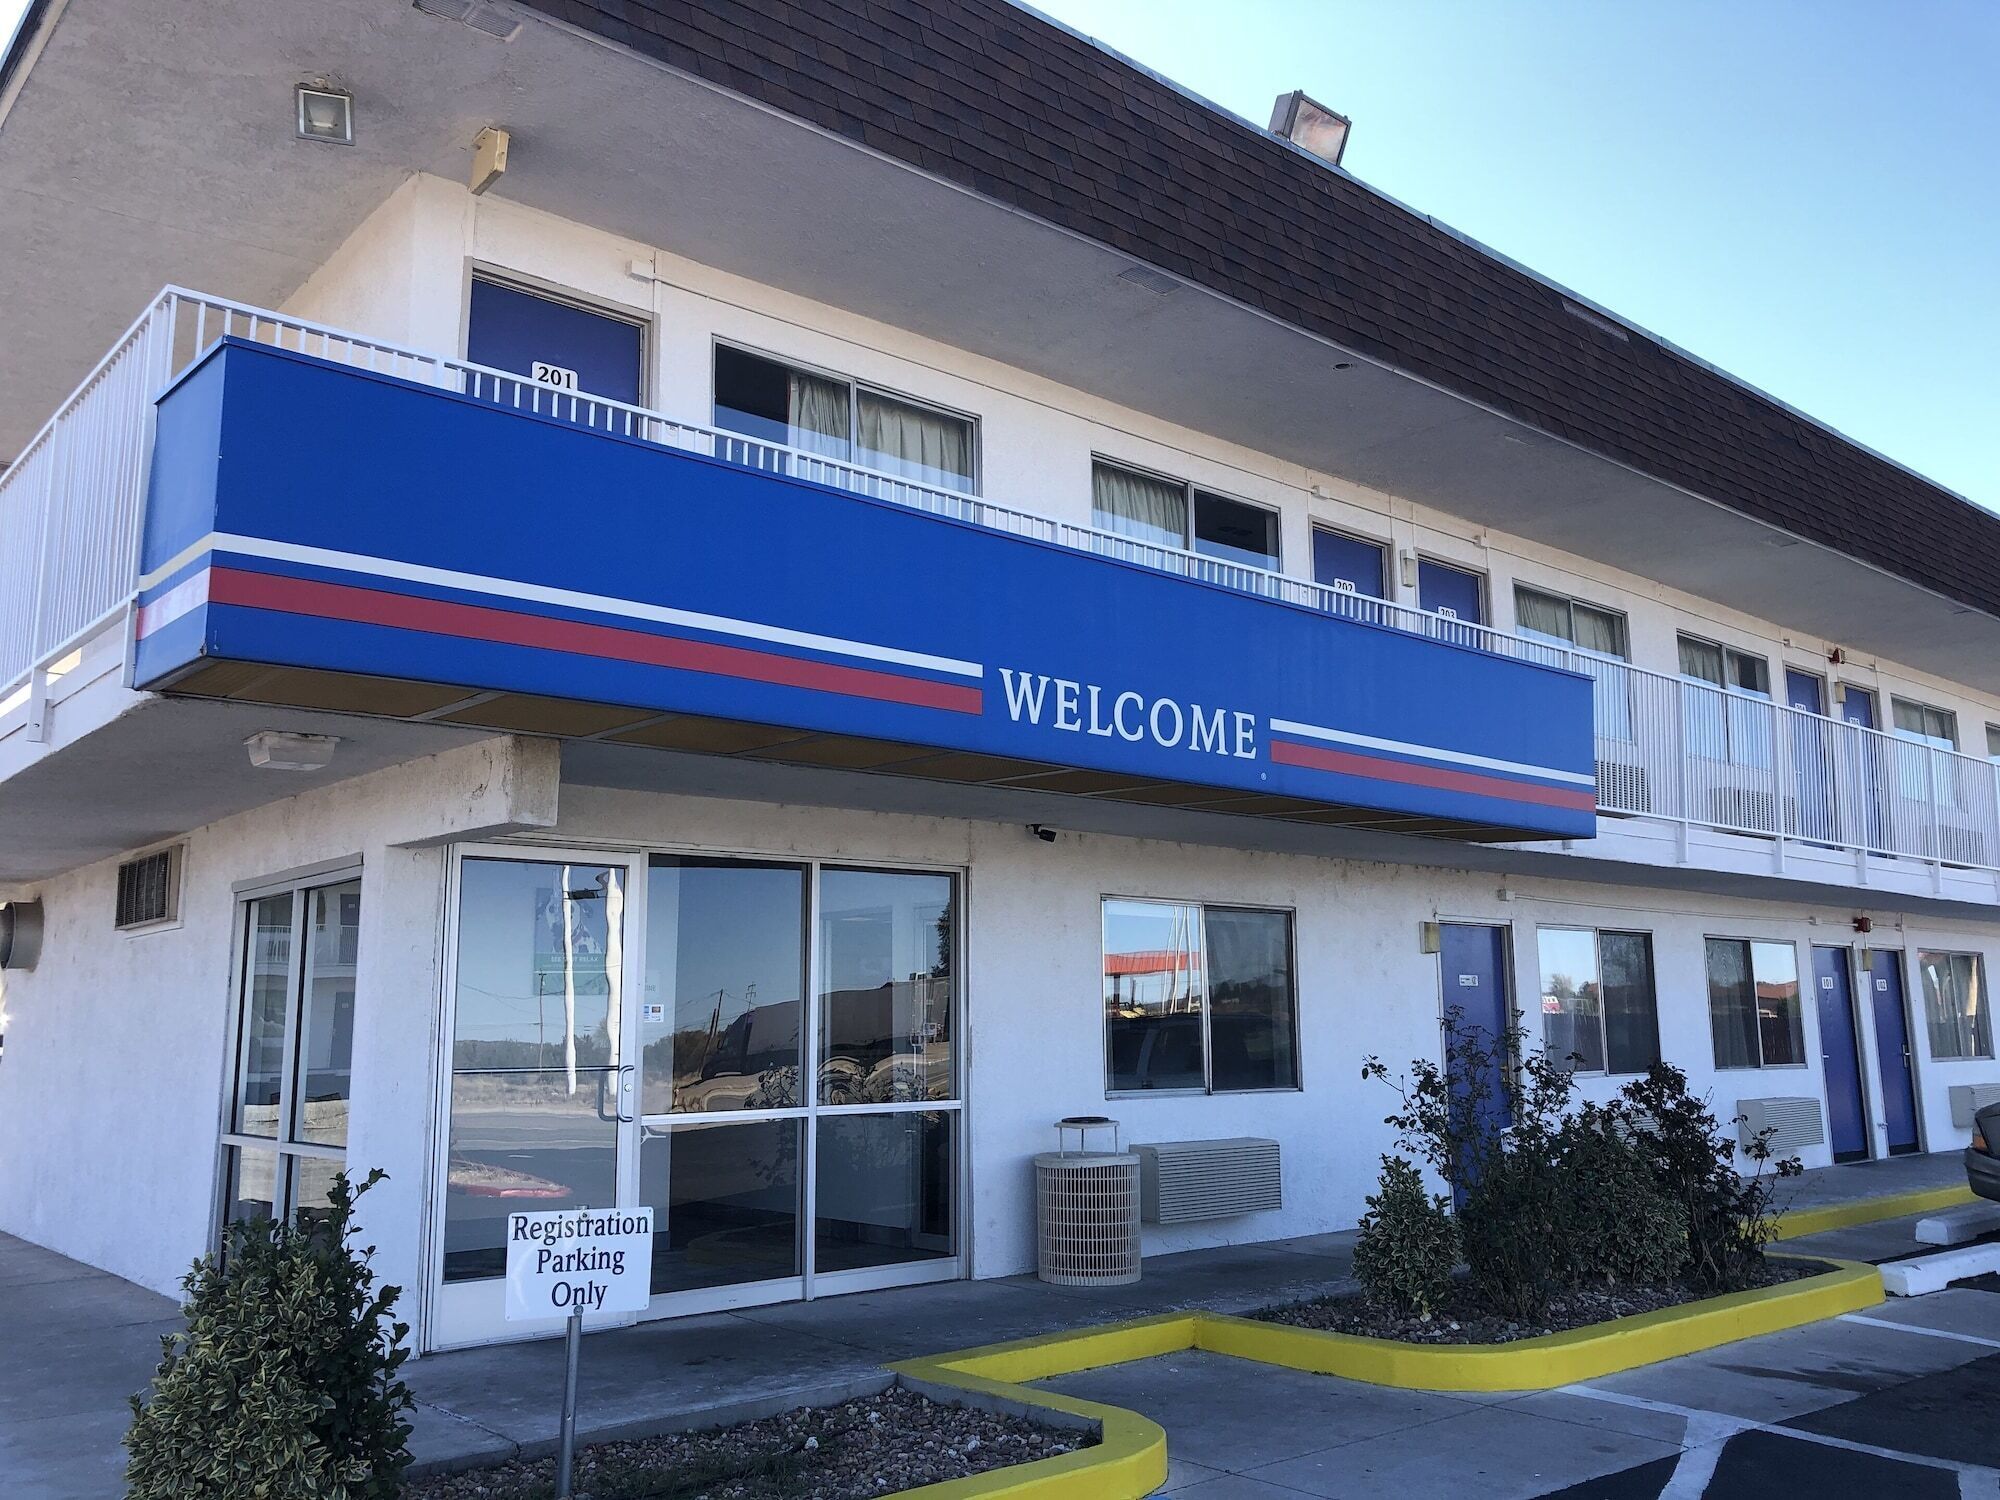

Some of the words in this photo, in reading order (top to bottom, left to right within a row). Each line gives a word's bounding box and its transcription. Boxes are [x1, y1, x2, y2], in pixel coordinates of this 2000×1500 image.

[537, 365, 572, 389] 201
[998, 667, 1257, 760] WELCOME
[511, 1211, 650, 1246] Registration
[536, 1246, 626, 1276] Parking
[551, 1280, 609, 1311] Only
